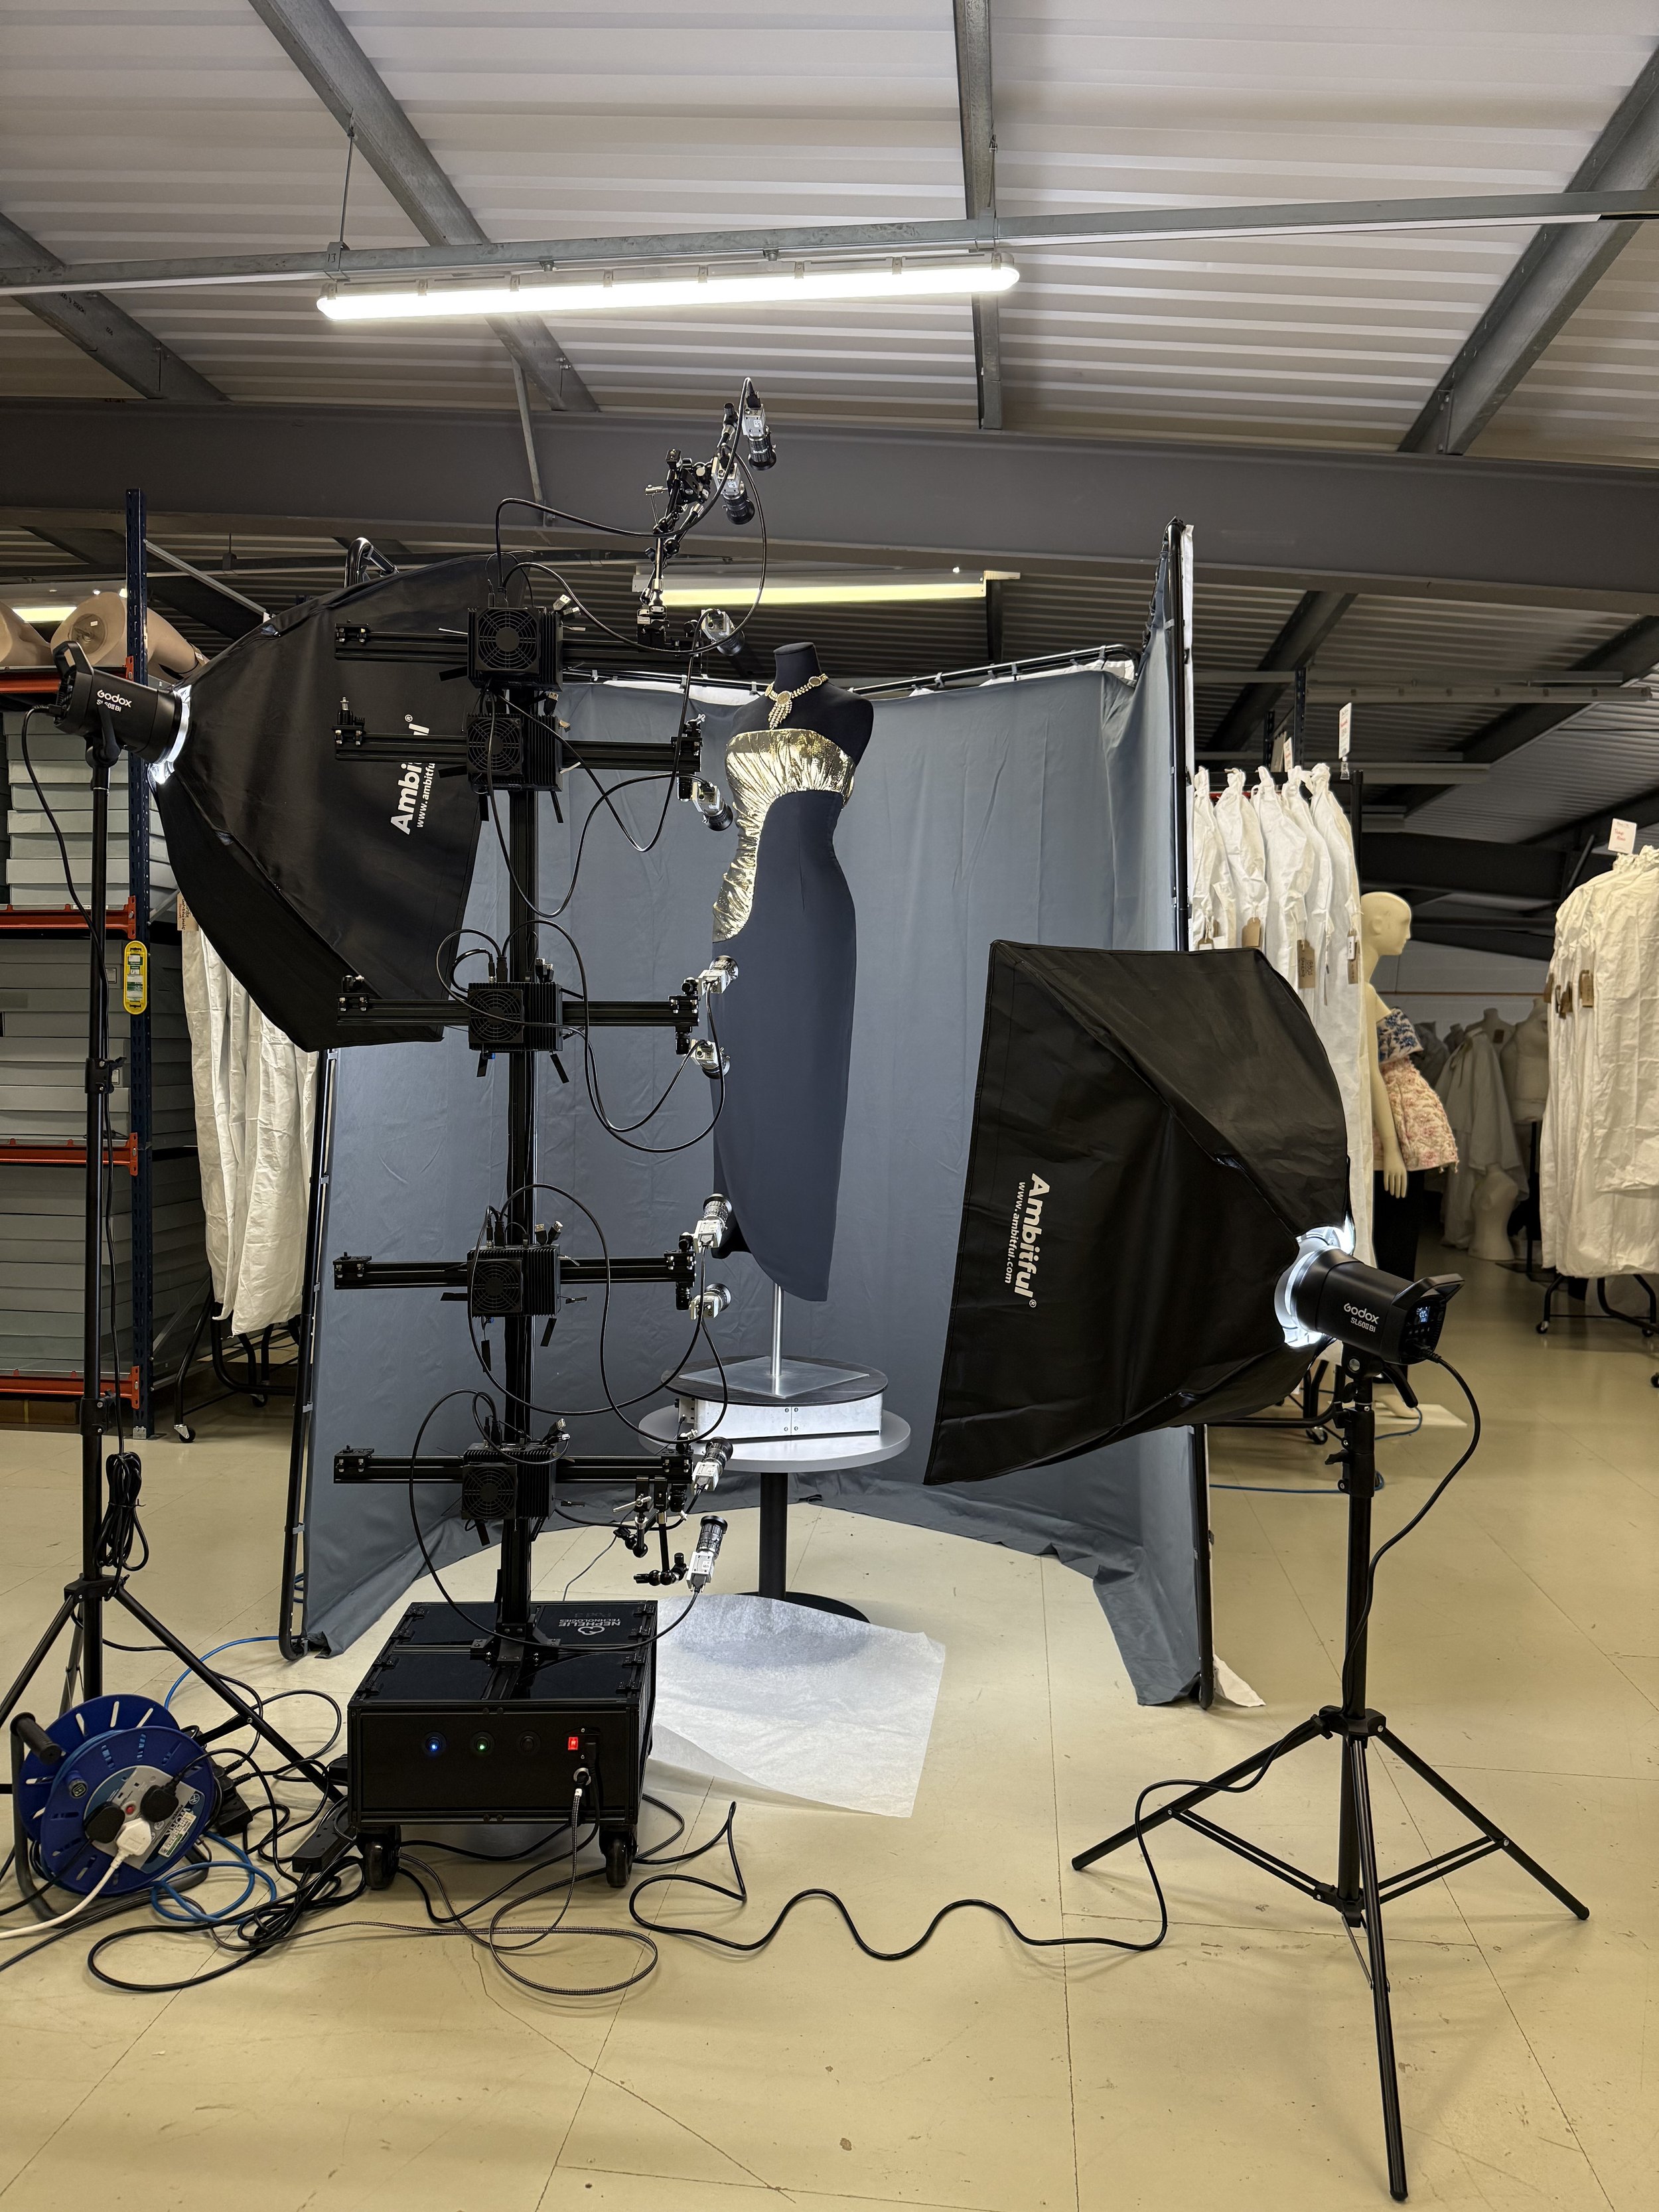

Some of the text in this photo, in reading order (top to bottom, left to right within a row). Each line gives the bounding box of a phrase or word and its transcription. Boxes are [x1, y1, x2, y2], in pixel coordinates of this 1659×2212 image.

[97, 690, 132, 708] Godox
[1005, 1181, 1026, 1284] www.ambitful.com
[1343, 1303, 1380, 1325] Godox
